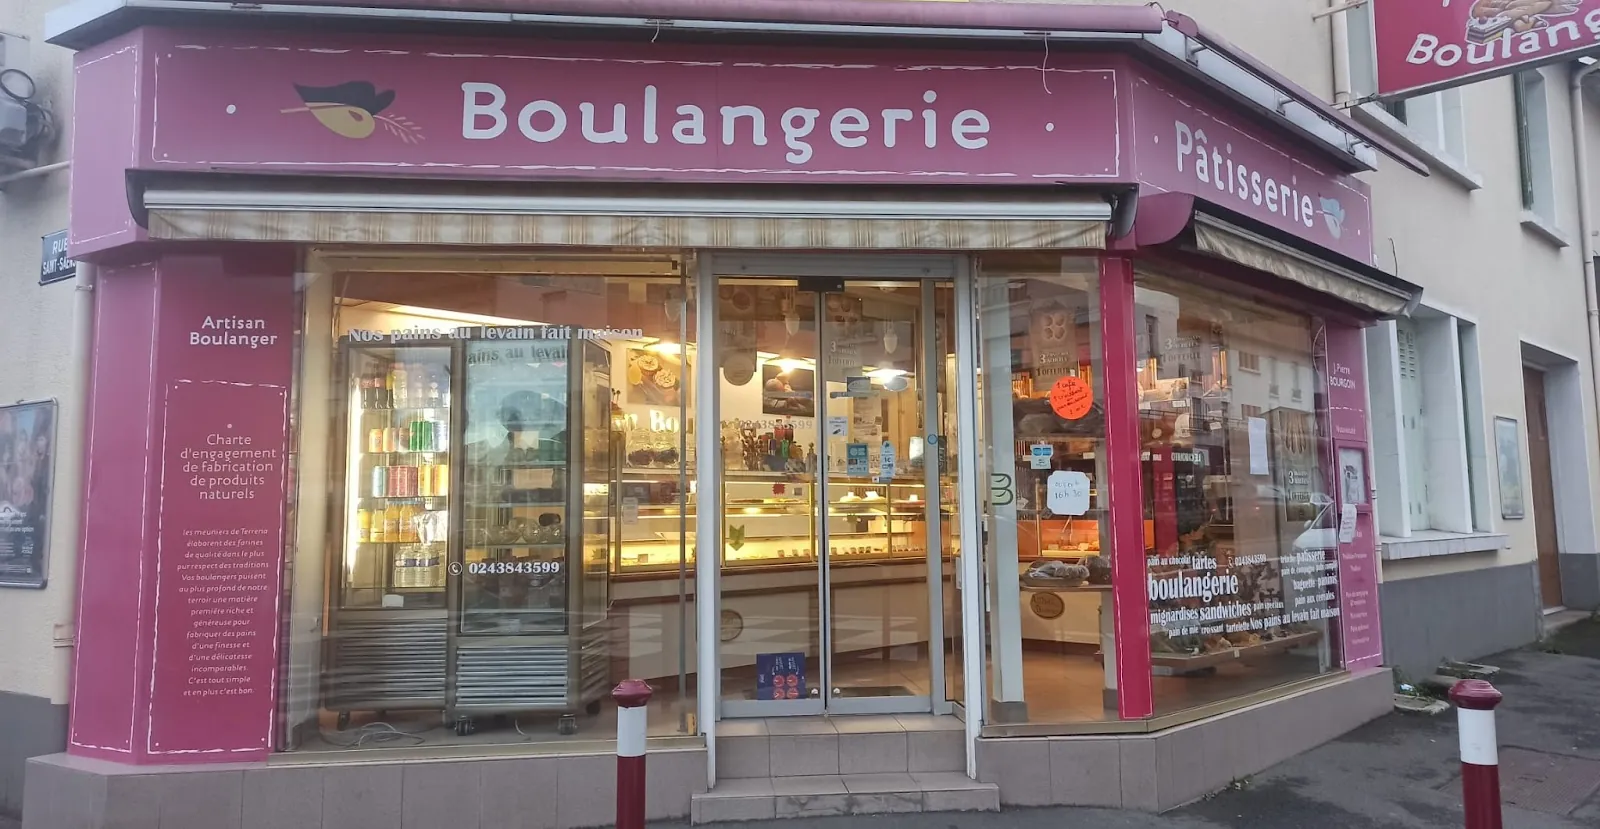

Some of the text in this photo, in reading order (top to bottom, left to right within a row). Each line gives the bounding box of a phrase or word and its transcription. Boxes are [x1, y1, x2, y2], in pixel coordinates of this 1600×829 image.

[461, 81, 991, 164] Boulangerie
[1174, 119, 1314, 228] Pâtisserie
[52, 237, 68, 255] RUE
[201, 315, 265, 329] Artisan
[189, 331, 277, 349] Boulanger
[348, 324, 643, 344] Nos pains au levain fait maison
[206, 433, 252, 446] Charte
[180, 447, 277, 463] d'engagement
[182, 459, 274, 473] de fabrication
[189, 474, 265, 489] de produits
[199, 487, 255, 500] naturels
[237, 539, 263, 547] farines
[468, 561, 560, 574] 0243843599
[1192, 555, 1217, 570] tartes
[206, 585, 236, 593] profond
[1147, 568, 1239, 603] boulangerie
[1150, 606, 1199, 627] mignardises
[1199, 600, 1252, 621] sandwiches
[1250, 616, 1263, 630] Nos
[1264, 613, 1281, 631] pains
[1282, 614, 1291, 624] au
[1291, 608, 1309, 623] levain
[1309, 607, 1320, 620] fait
[1321, 605, 1340, 619] maison
[193, 620, 232, 628] généreuse
[186, 631, 221, 639] fabriquer
[236, 630, 256, 638] pains
[191, 664, 249, 672] incomparables.
